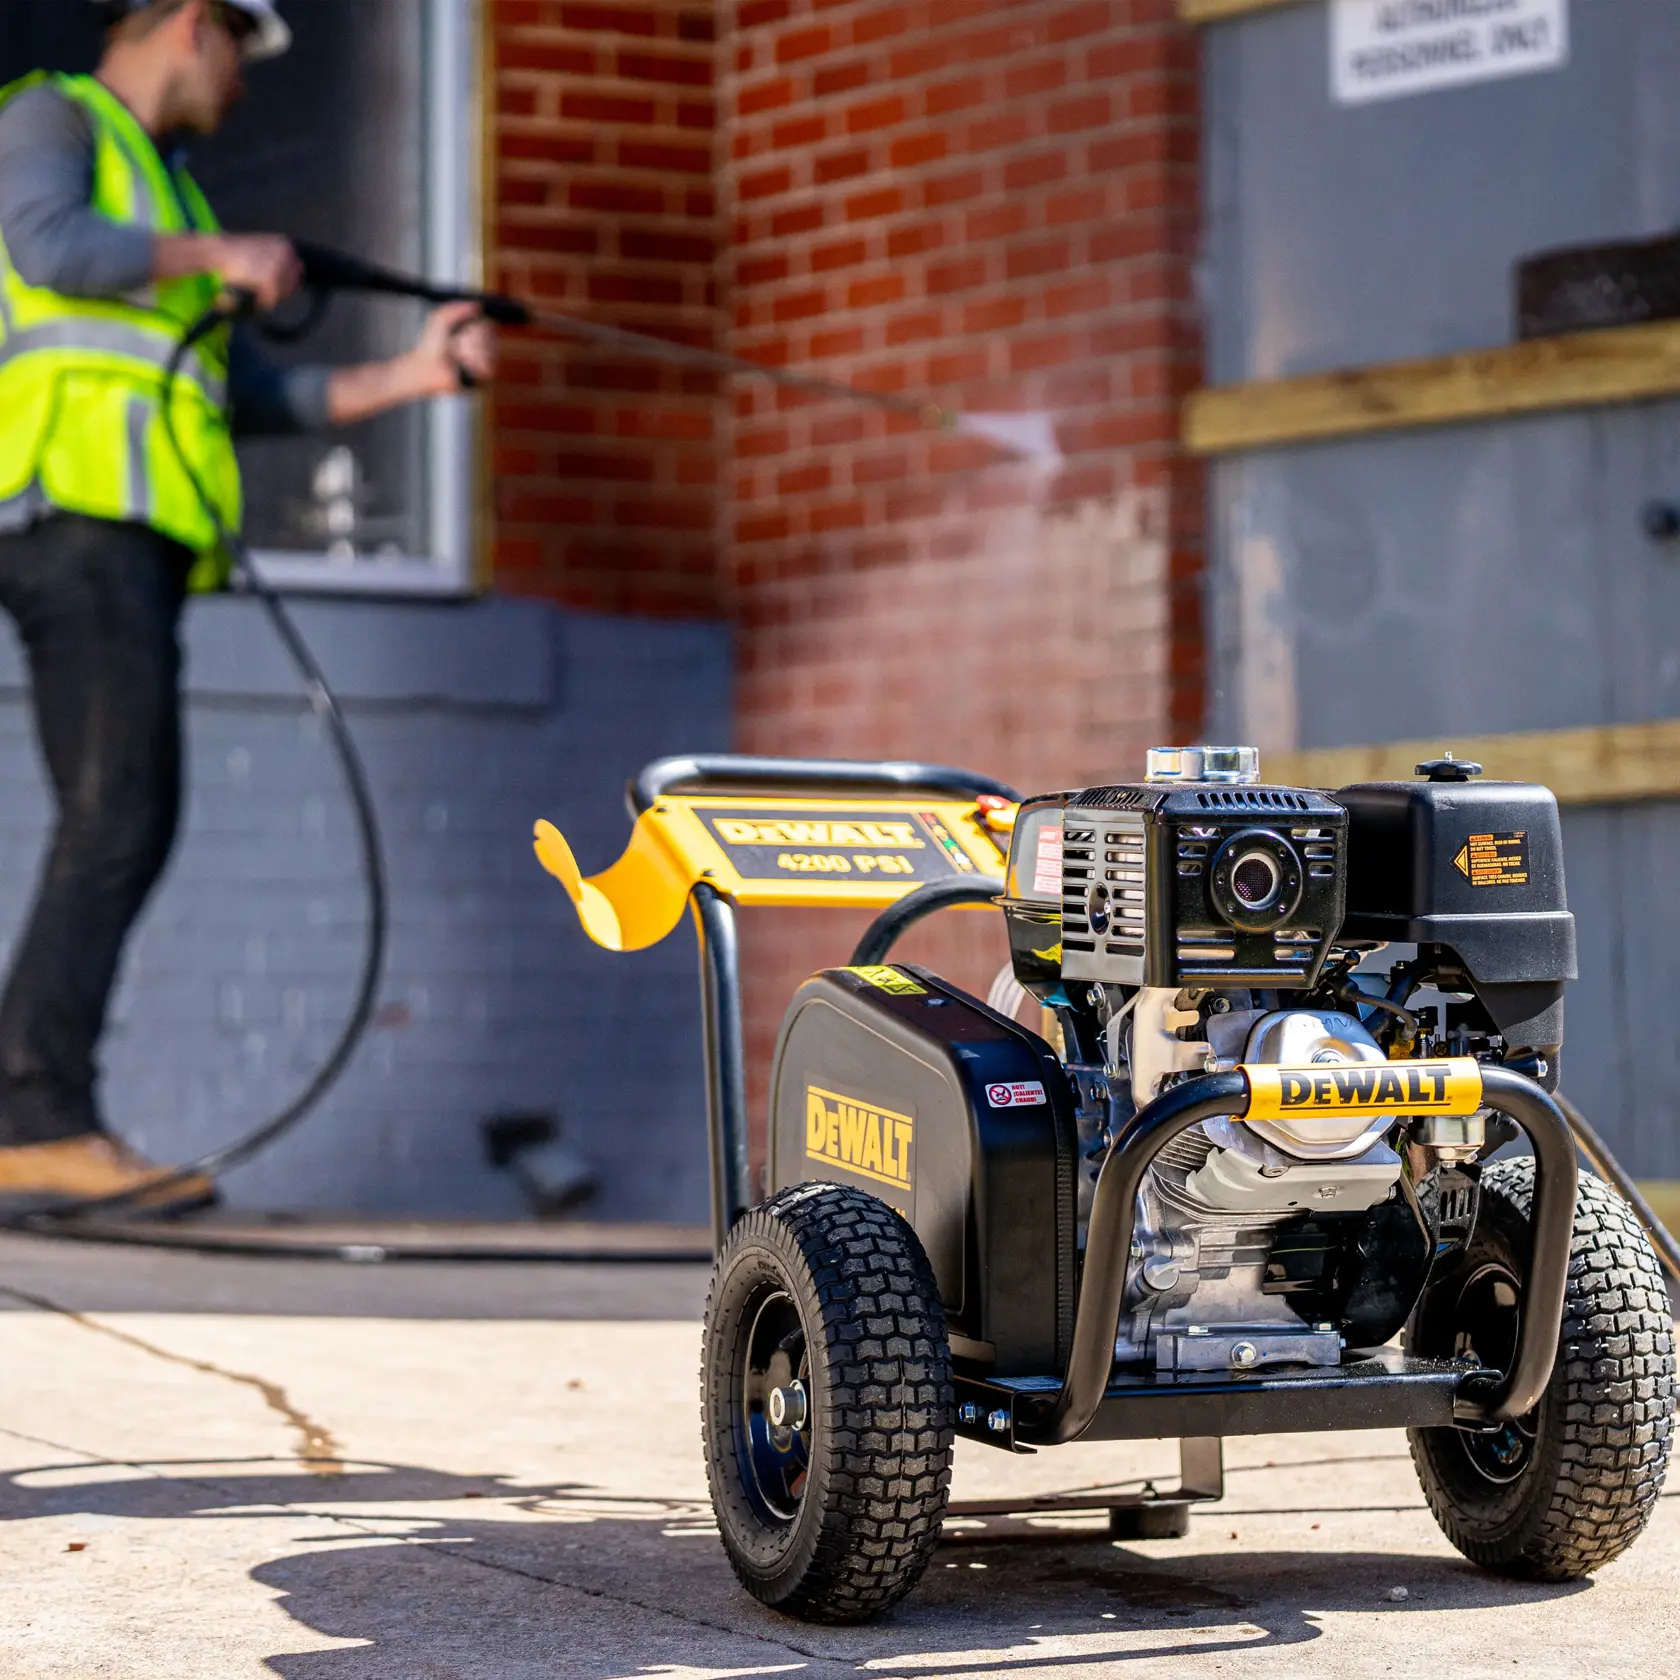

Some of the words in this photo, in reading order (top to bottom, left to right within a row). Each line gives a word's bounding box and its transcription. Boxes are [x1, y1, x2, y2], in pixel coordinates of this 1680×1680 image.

[777, 852, 850, 873] 4200
[853, 855, 914, 874] PSI
[1279, 1068, 1452, 1106] DEWALT
[806, 1093, 912, 1181] DEWALT
